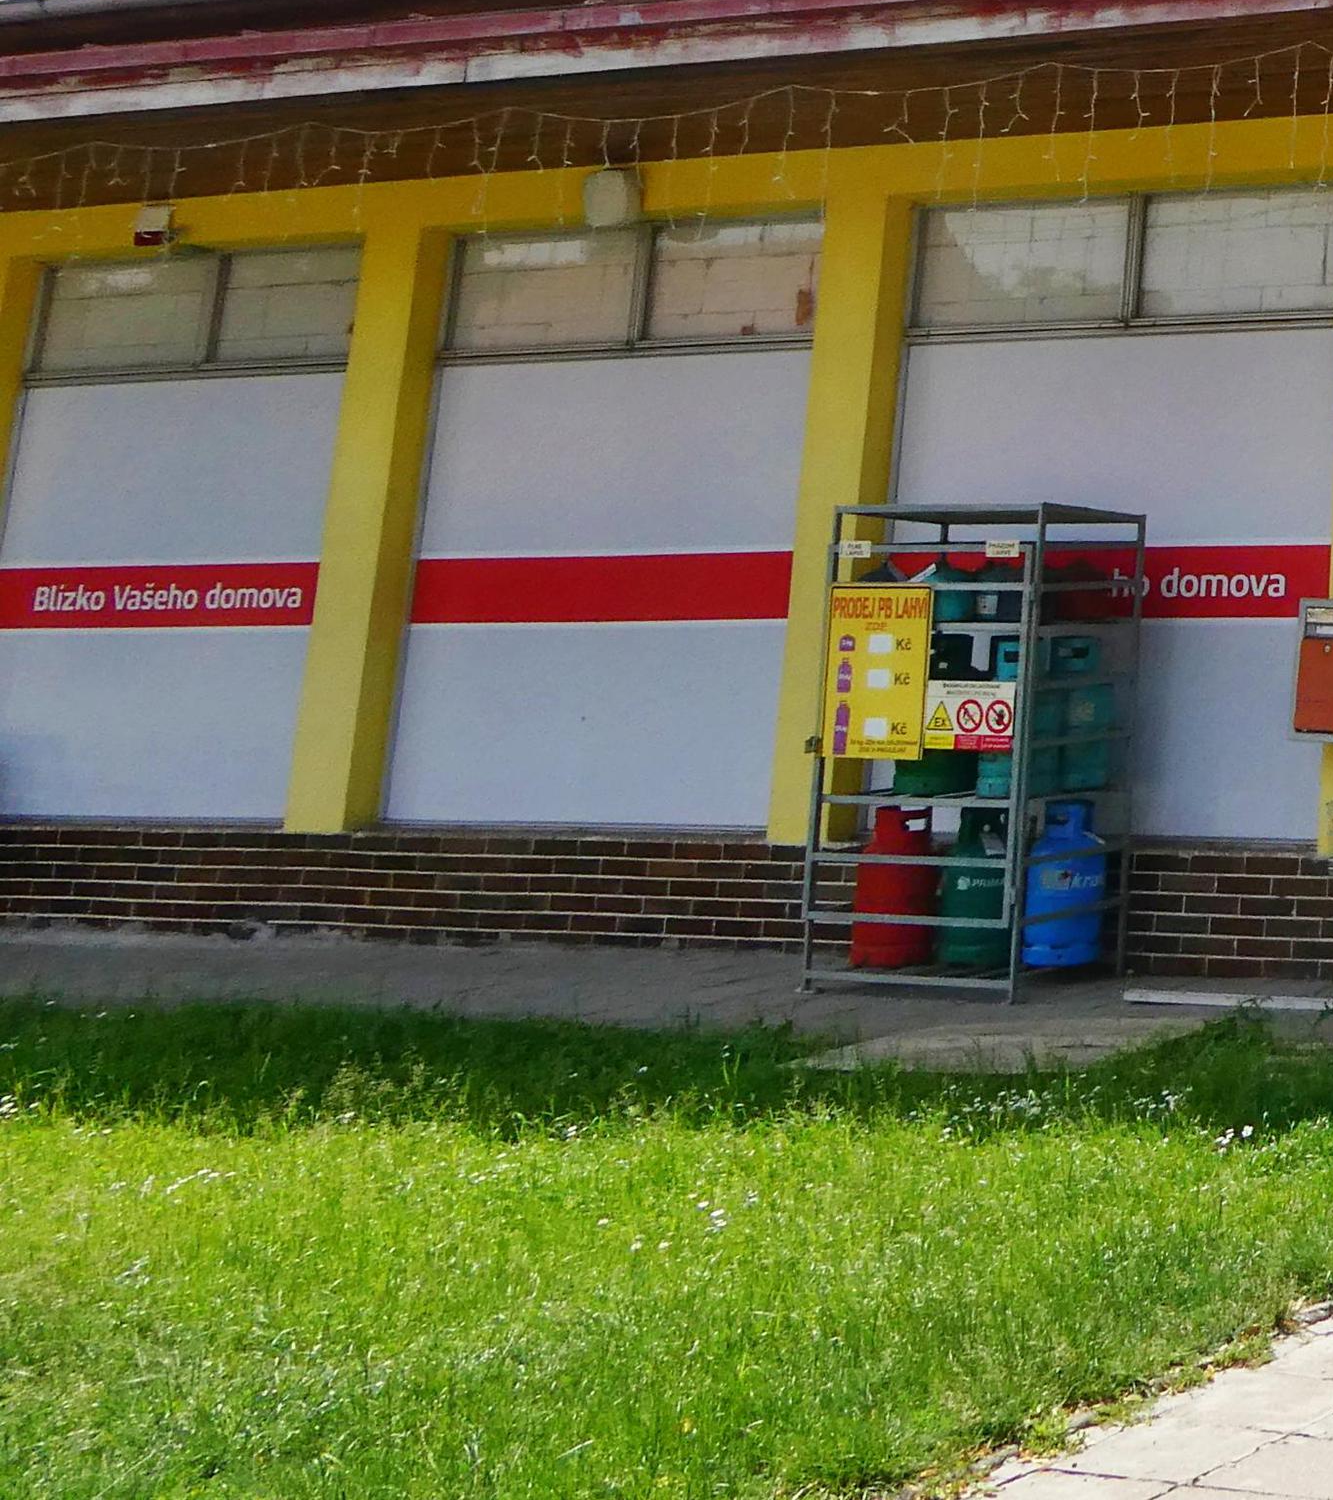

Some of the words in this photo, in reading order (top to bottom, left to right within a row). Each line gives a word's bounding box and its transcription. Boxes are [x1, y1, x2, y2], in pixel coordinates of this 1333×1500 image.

[1160, 566, 1286, 598] domova
[33, 583, 105, 611] Blízko
[112, 582, 198, 611] Vašeho
[204, 582, 303, 609] domova
[832, 596, 876, 619] PRODEJ
[878, 596, 893, 619] PB
[895, 636, 912, 651] Kč
[893, 671, 911, 686] Kč
[890, 721, 907, 735] Kč
